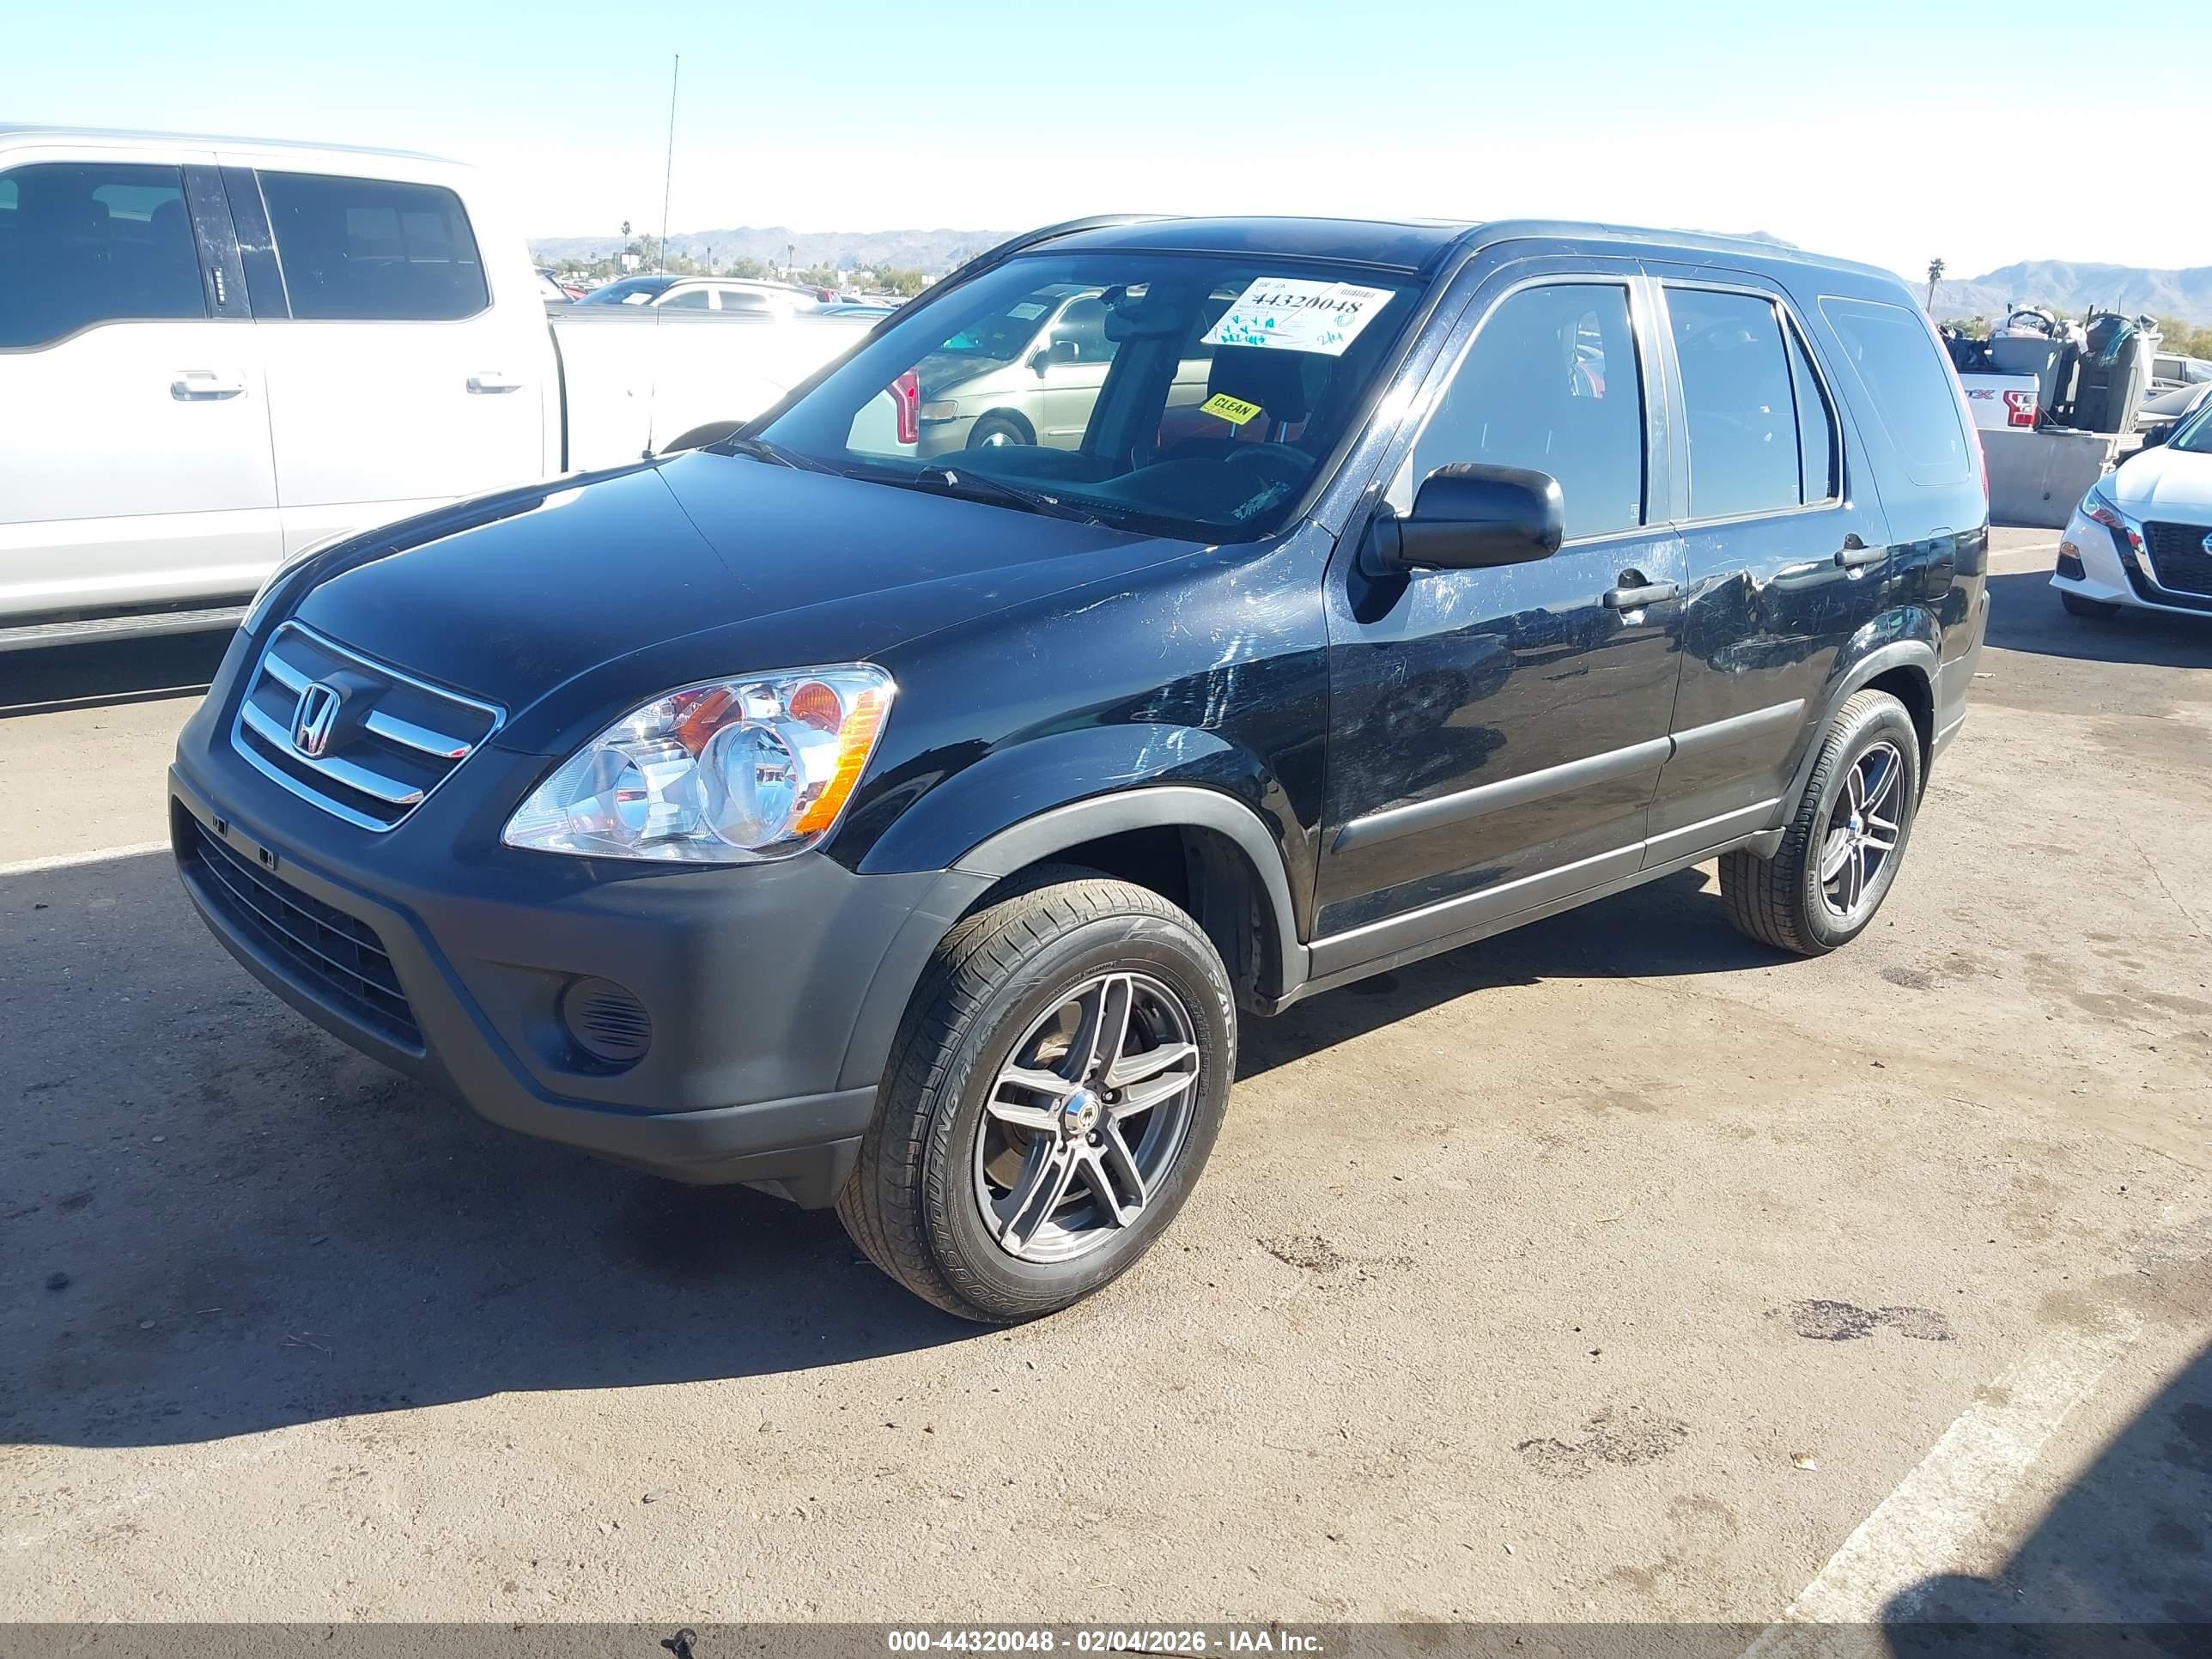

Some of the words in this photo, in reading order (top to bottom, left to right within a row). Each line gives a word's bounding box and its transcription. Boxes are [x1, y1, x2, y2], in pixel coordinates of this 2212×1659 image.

[1252, 293, 1364, 314] 44320048
[1213, 398, 1252, 416] CLEAN
[928, 1081, 960, 1243] TOURING
